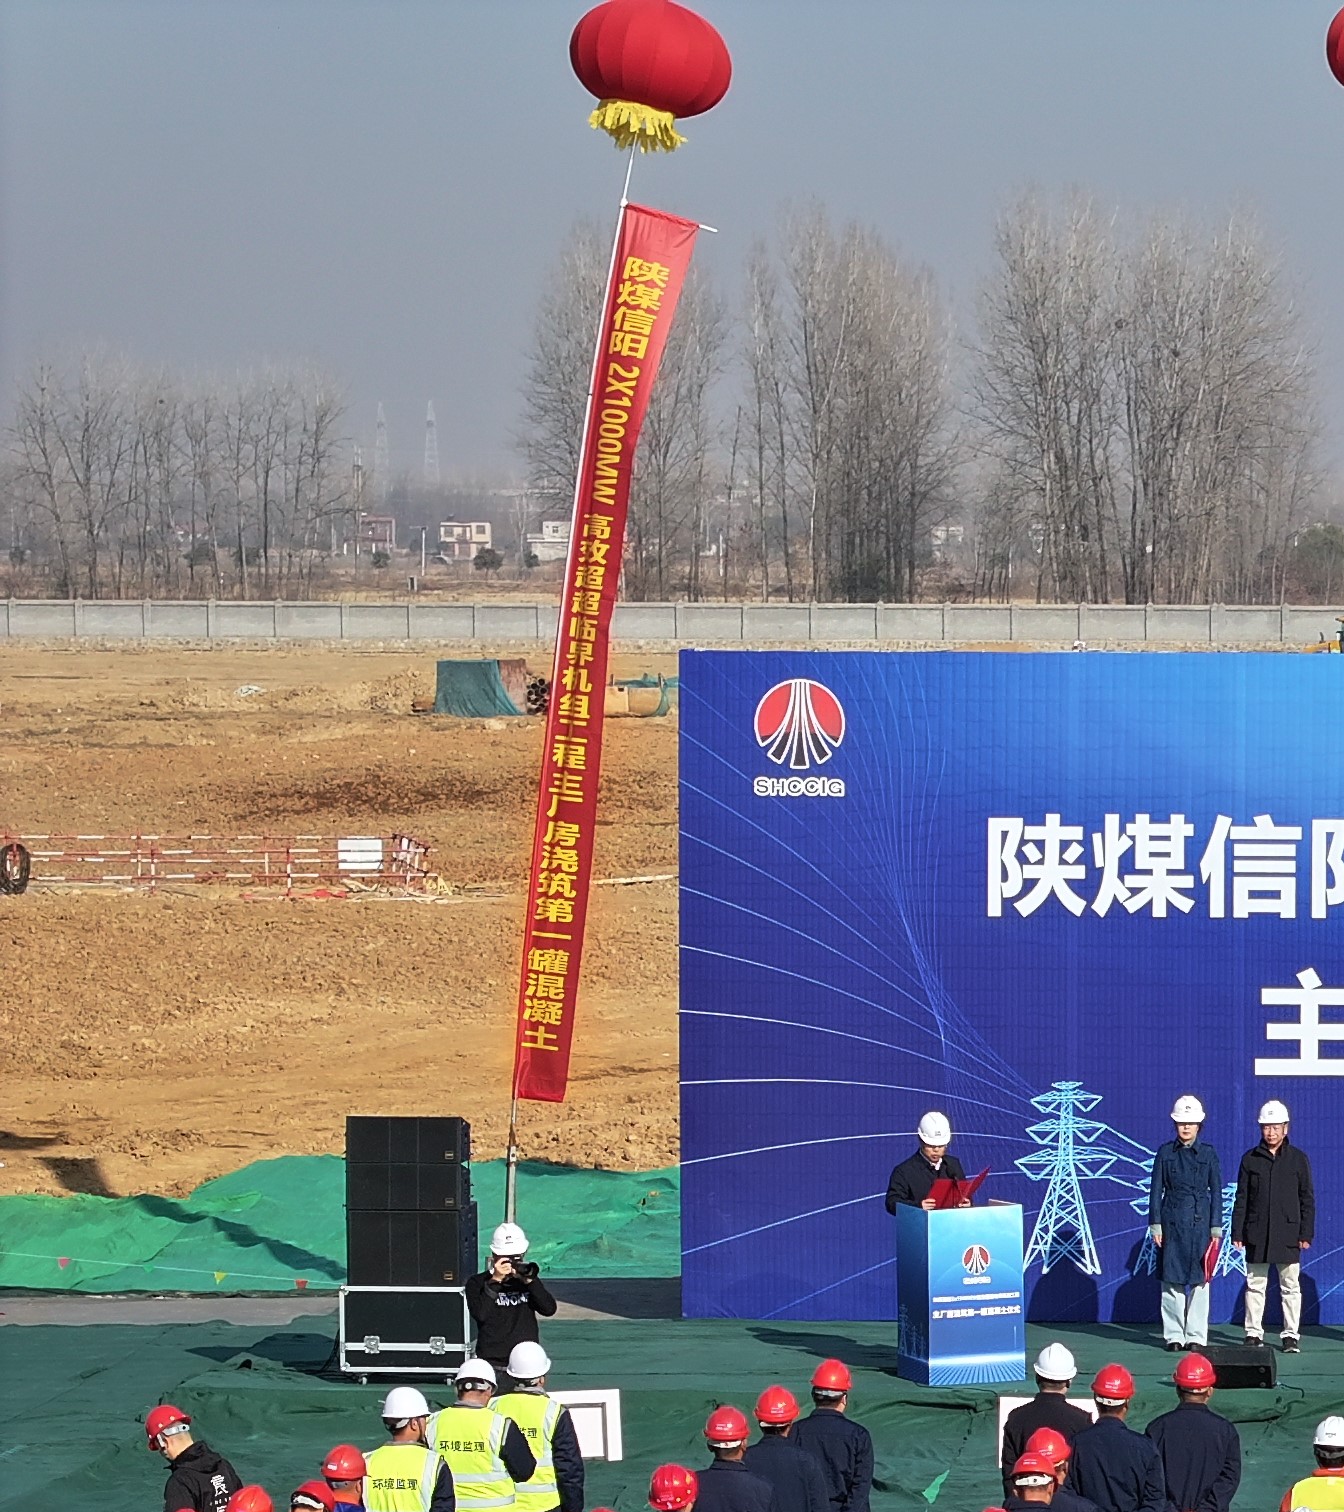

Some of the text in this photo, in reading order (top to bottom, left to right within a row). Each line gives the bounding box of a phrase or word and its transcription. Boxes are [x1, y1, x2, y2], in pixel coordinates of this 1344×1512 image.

[608, 256, 670, 359] 陕煤信阳
[592, 362, 640, 506] 2X1000MW
[439, 1440, 485, 1452] 环境监理
[372, 1478, 418, 1490] 环境监理
